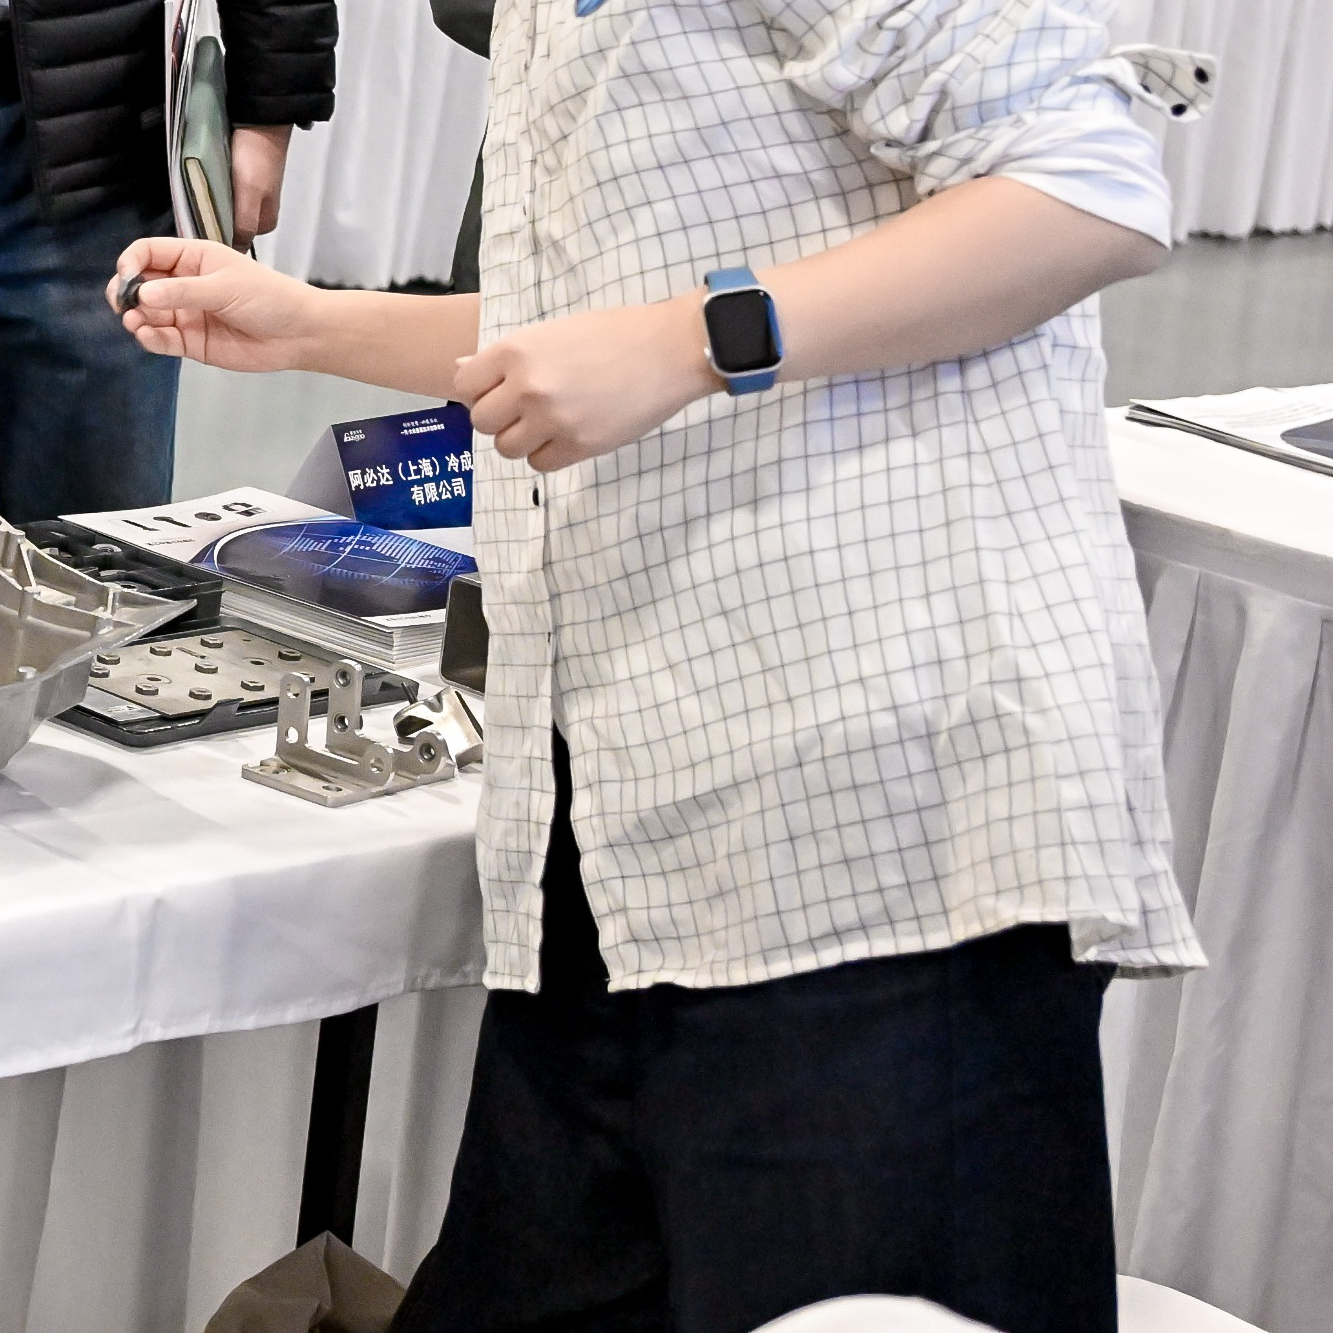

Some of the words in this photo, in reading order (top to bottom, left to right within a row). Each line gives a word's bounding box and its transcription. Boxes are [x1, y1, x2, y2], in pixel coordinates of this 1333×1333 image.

[348, 450, 474, 491] 阿必达（上海）冷成
[411, 478, 466, 506] 有限公司
